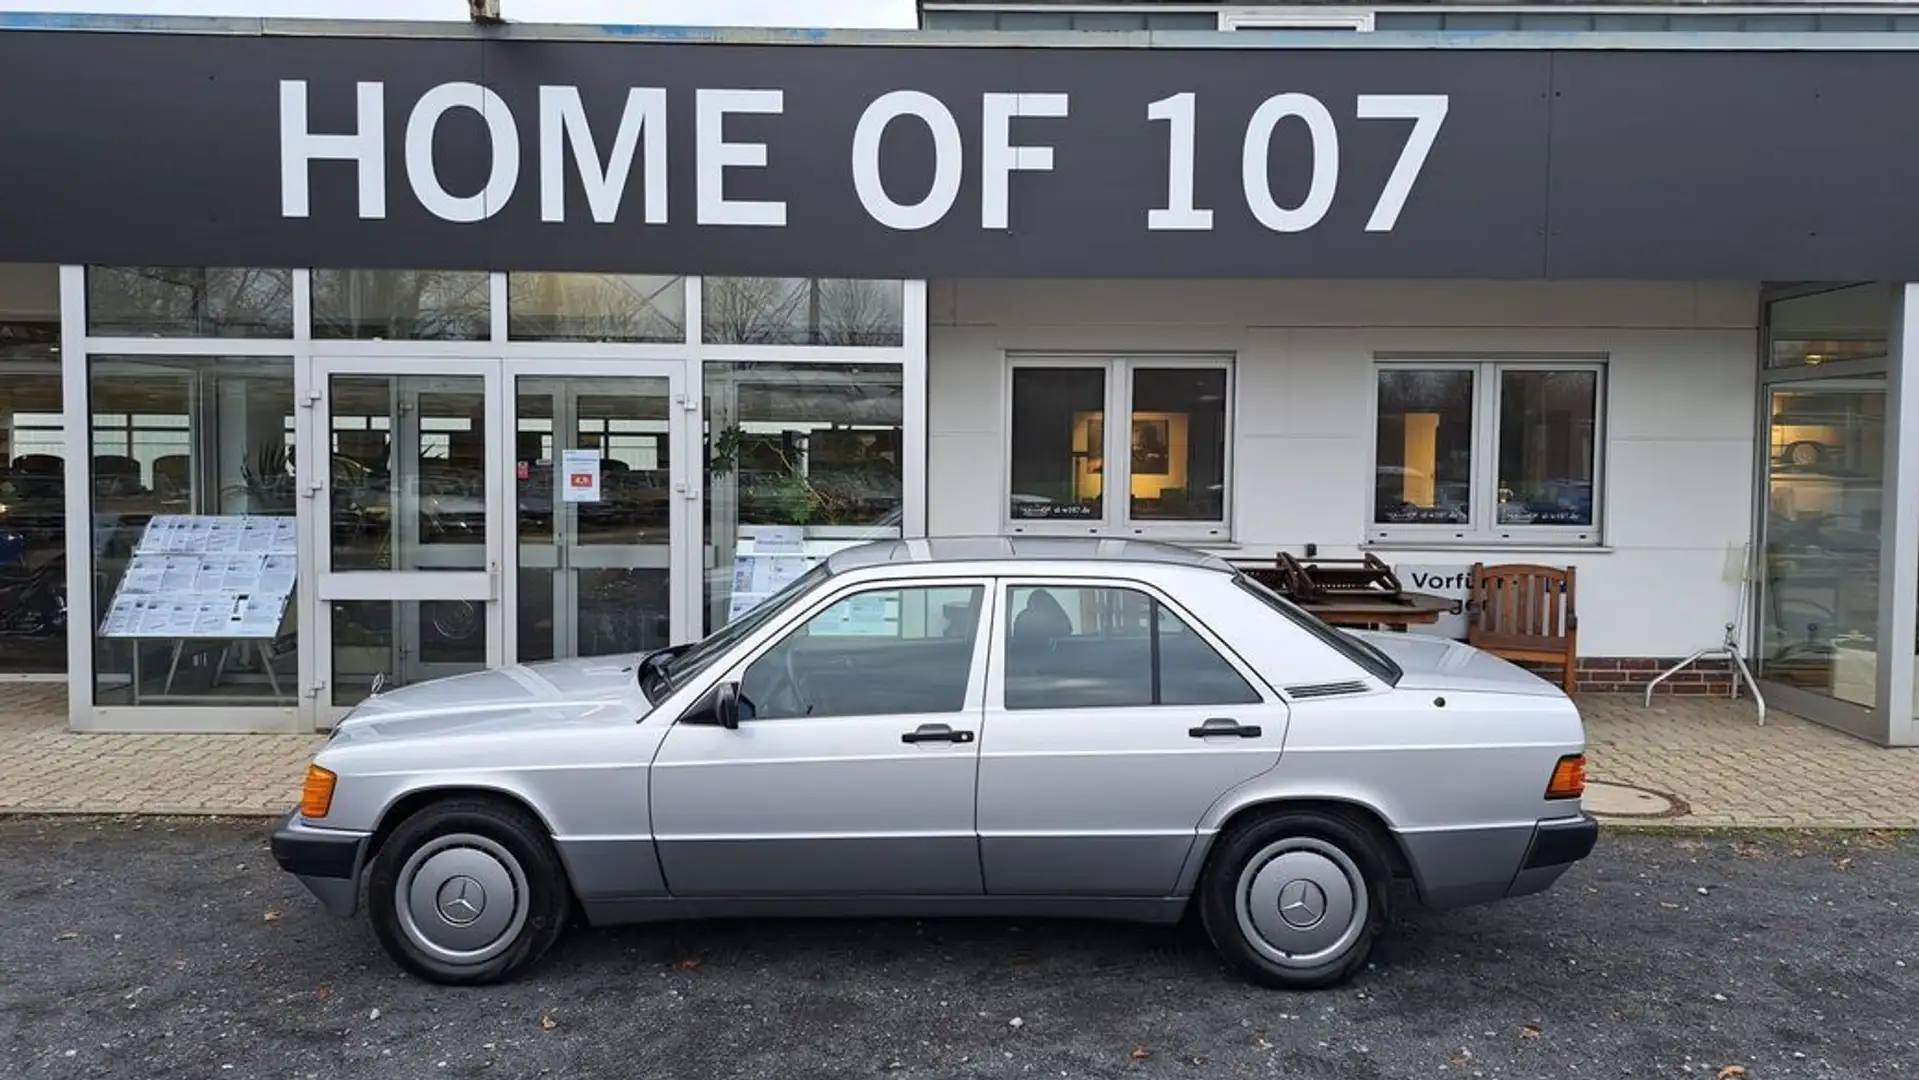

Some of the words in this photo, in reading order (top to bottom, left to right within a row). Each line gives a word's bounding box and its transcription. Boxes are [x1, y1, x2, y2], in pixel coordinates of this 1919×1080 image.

[280, 80, 787, 227] HOME
[852, 90, 1068, 230] OF
[1148, 92, 1449, 232] 107
